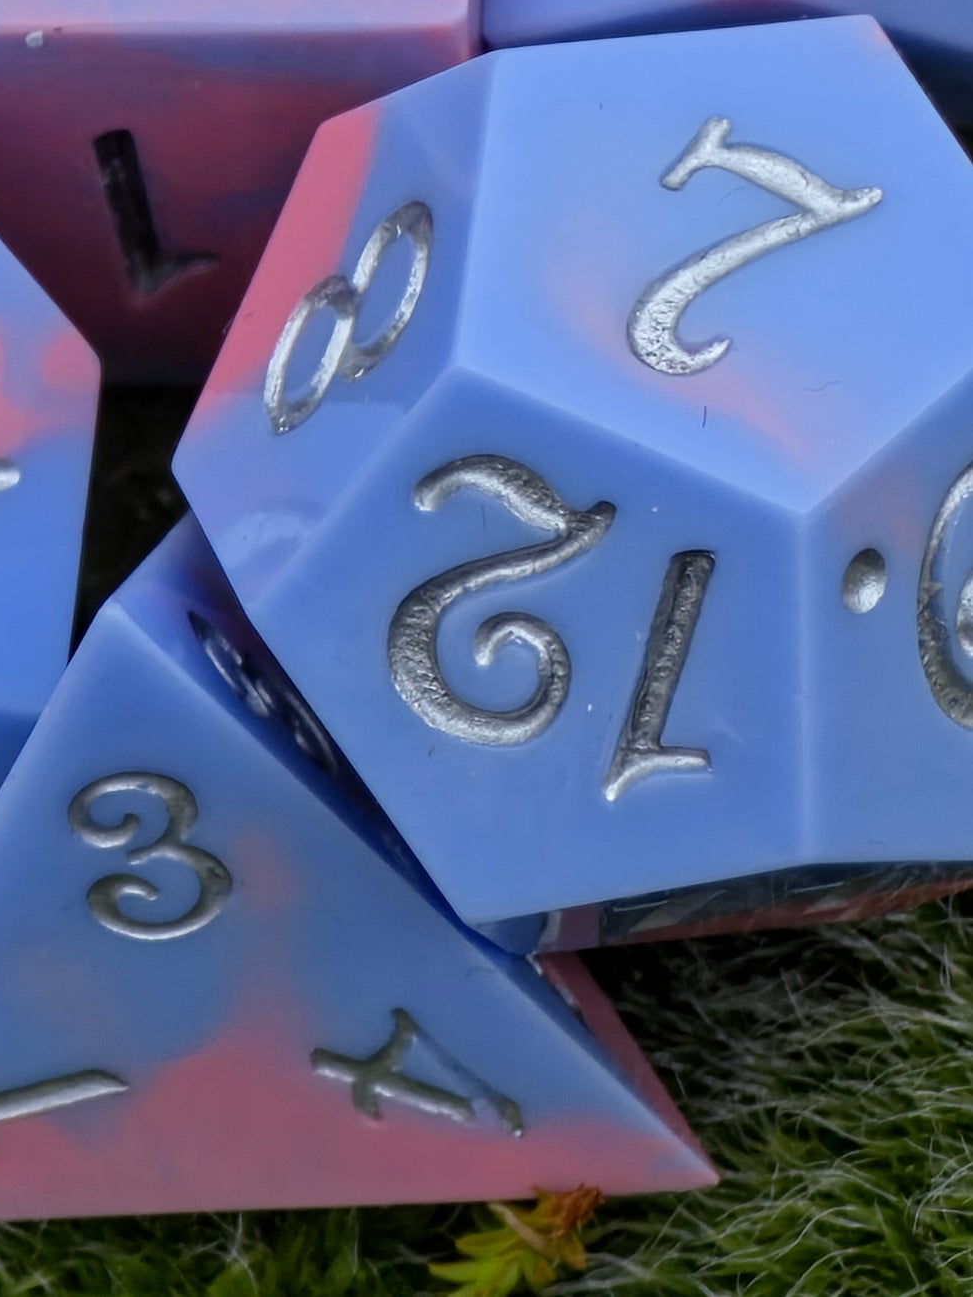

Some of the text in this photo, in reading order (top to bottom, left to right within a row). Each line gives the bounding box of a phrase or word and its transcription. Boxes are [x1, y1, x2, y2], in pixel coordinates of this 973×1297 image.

[263, 200, 433, 435] 8
[387, 453, 717, 802] 12
[67, 770, 233, 941] 3
[311, 1007, 525, 1139] 4
